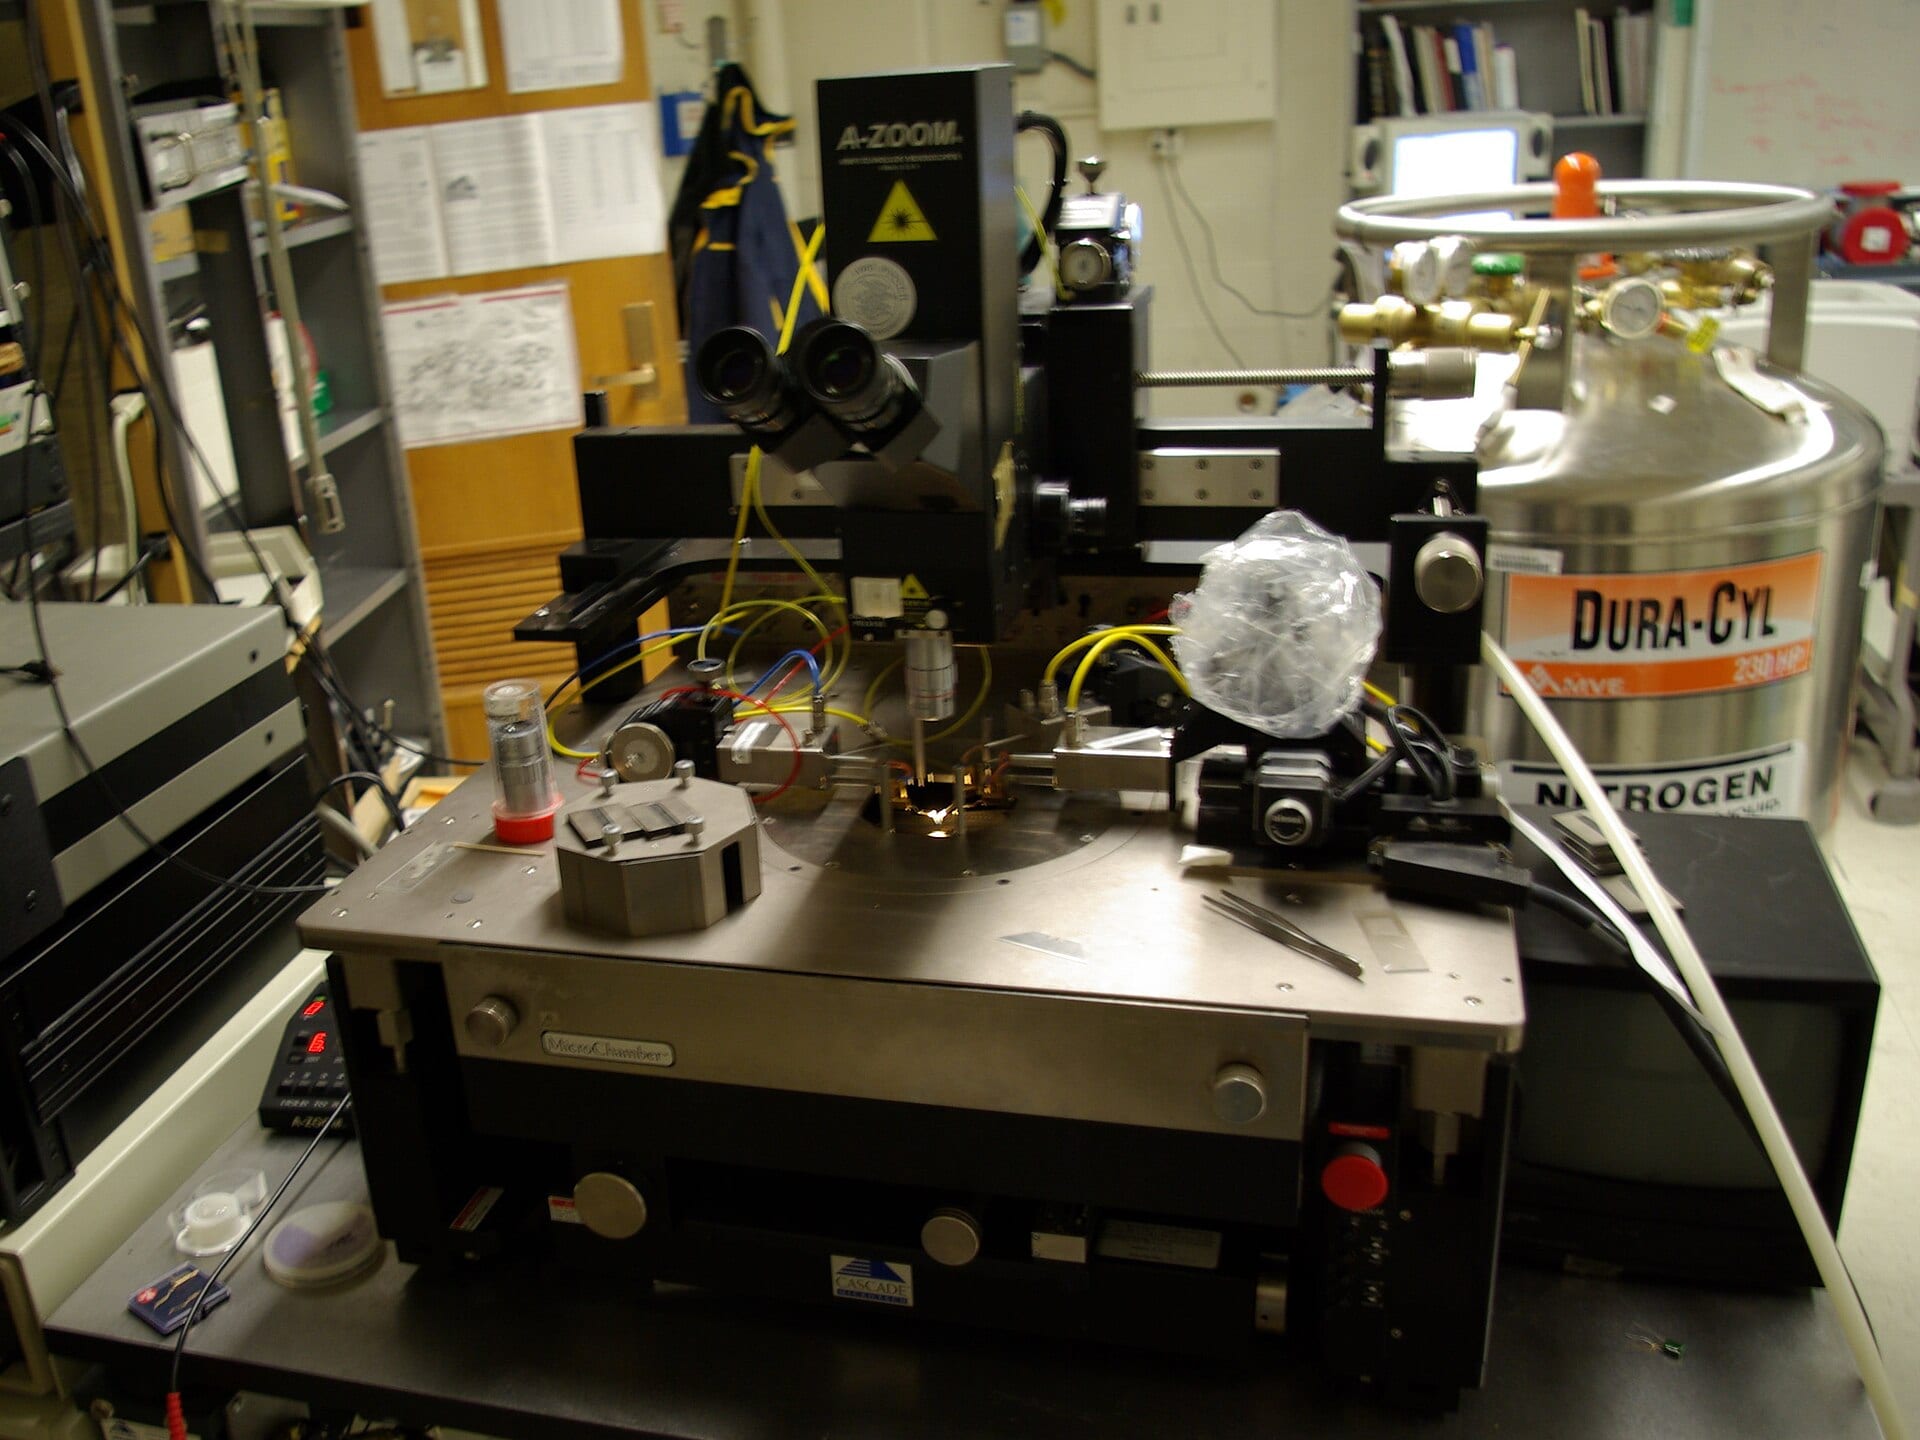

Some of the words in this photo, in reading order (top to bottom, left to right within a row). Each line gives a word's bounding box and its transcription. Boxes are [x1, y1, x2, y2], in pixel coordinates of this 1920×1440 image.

[836, 120, 958, 151] A-ZOOM
[1573, 581, 1775, 651] DURA-CYL
[836, 1276, 907, 1297] CASCADE
